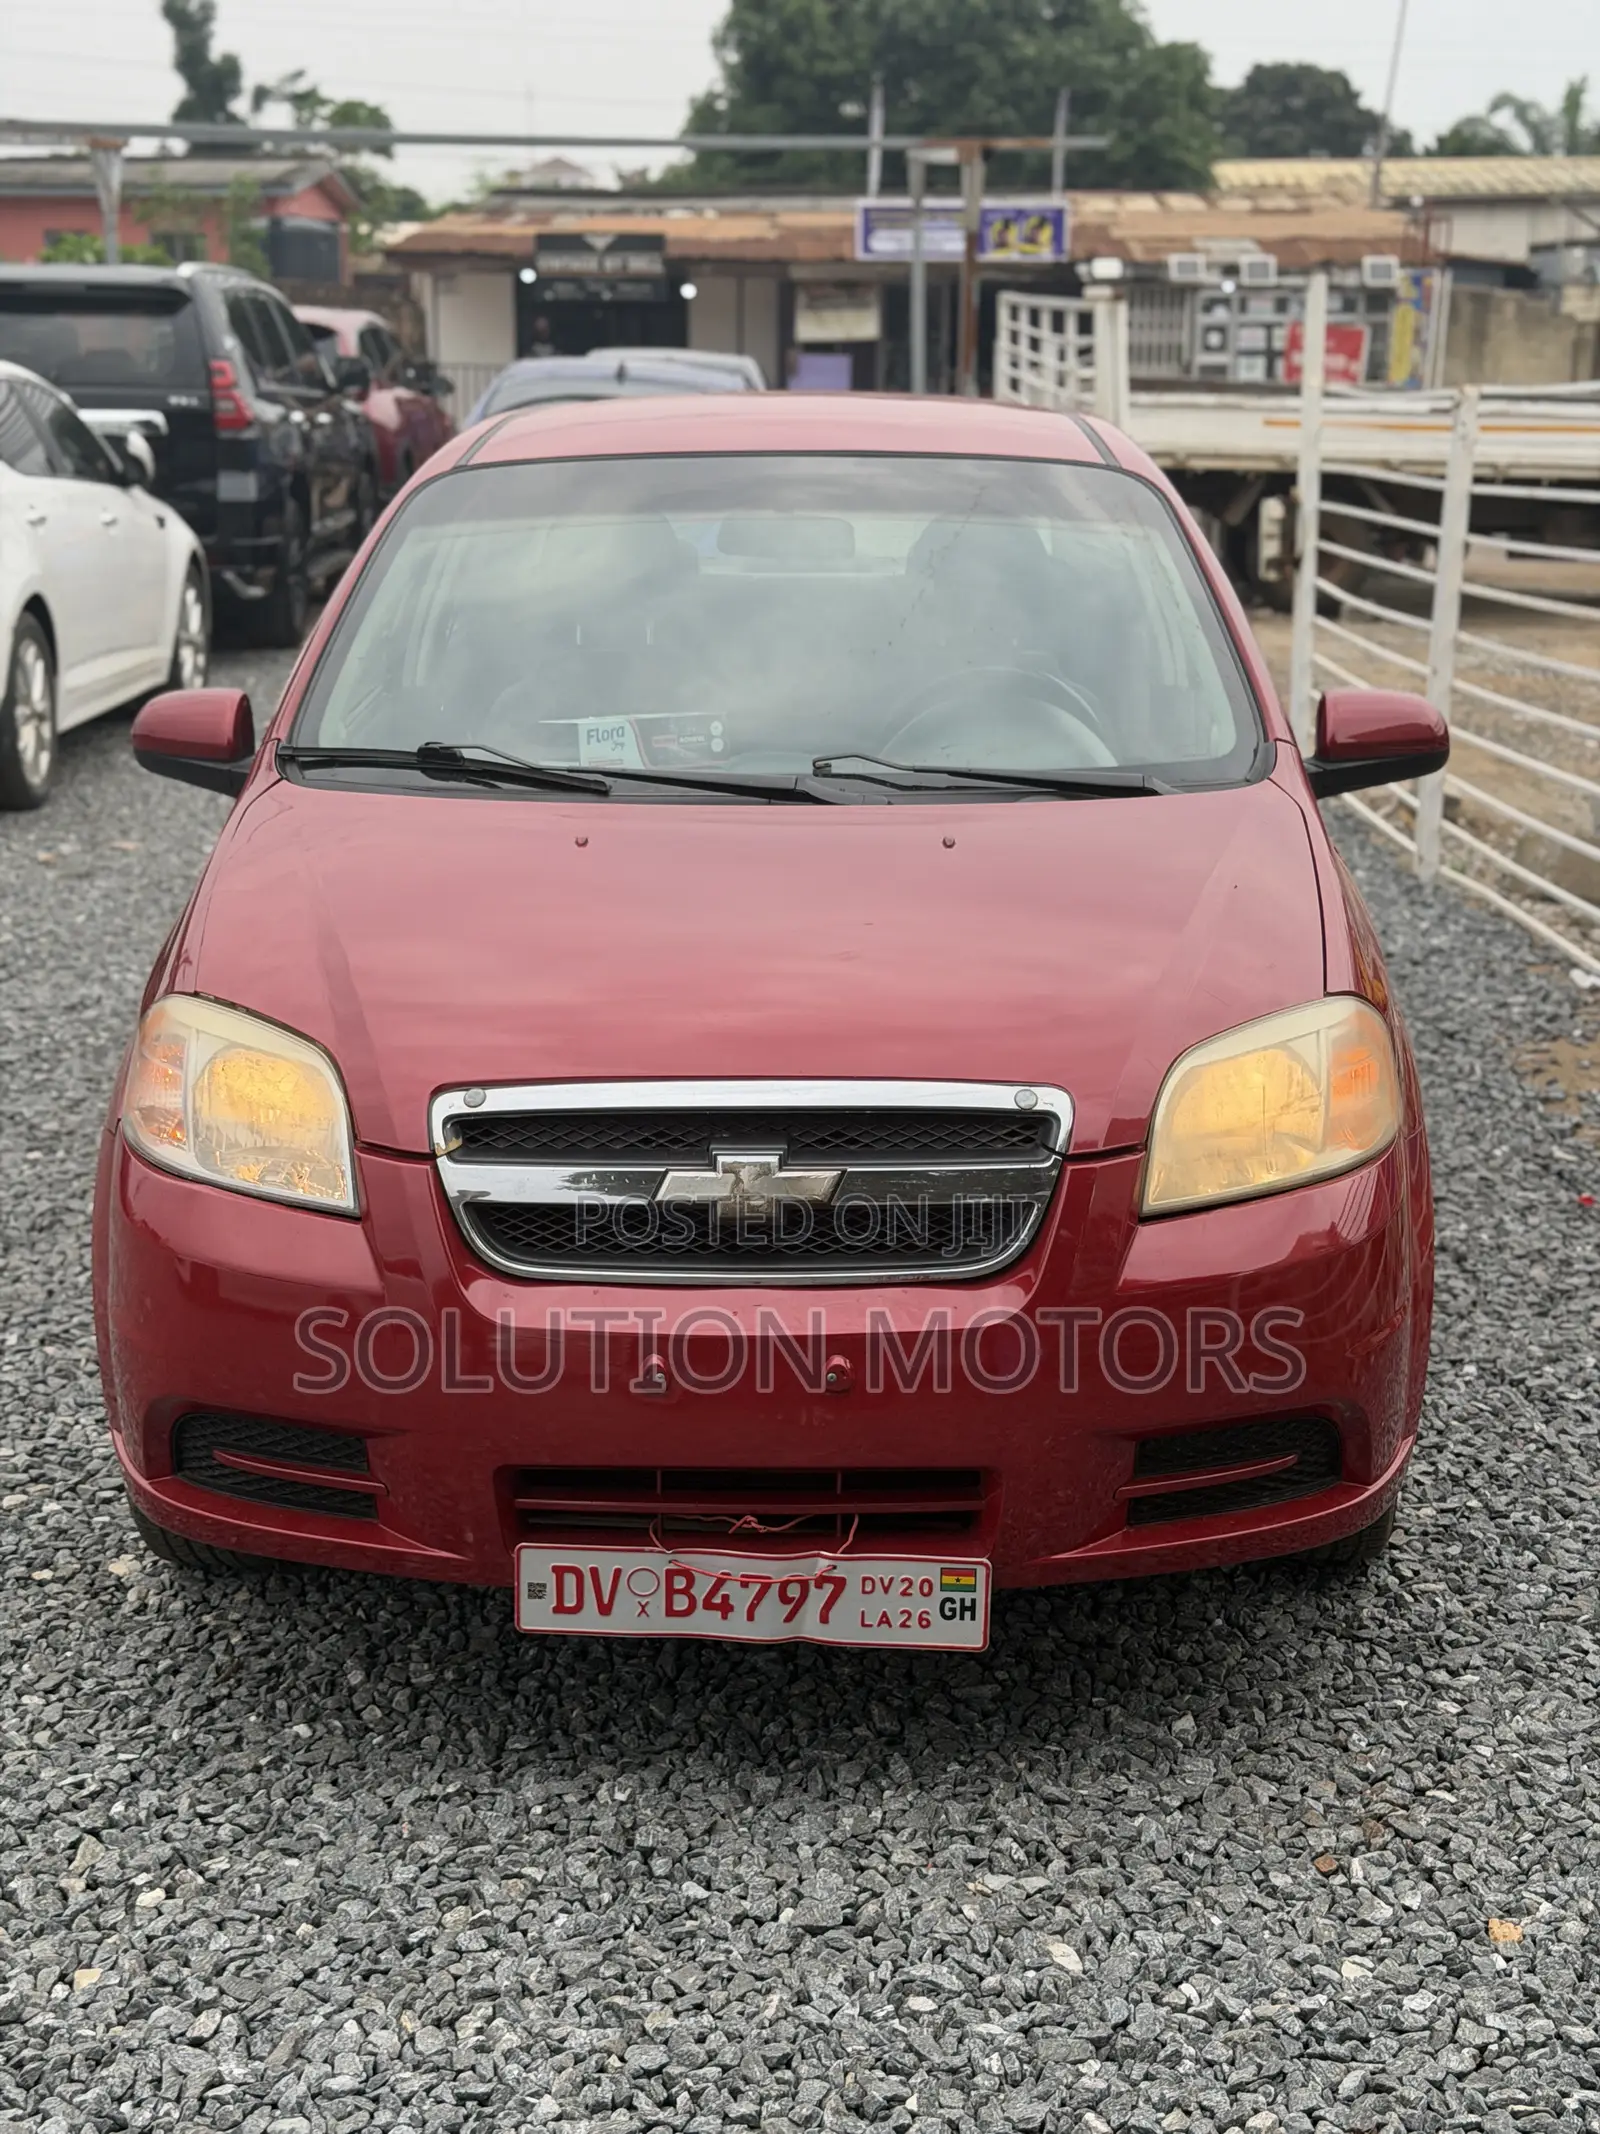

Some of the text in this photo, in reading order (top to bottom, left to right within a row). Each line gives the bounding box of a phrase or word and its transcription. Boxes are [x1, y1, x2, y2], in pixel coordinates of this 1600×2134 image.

[586, 726, 625, 746] Flora
[551, 1564, 622, 1617] DV
[664, 1567, 847, 1625] B4797
[939, 1596, 977, 1622] GH
